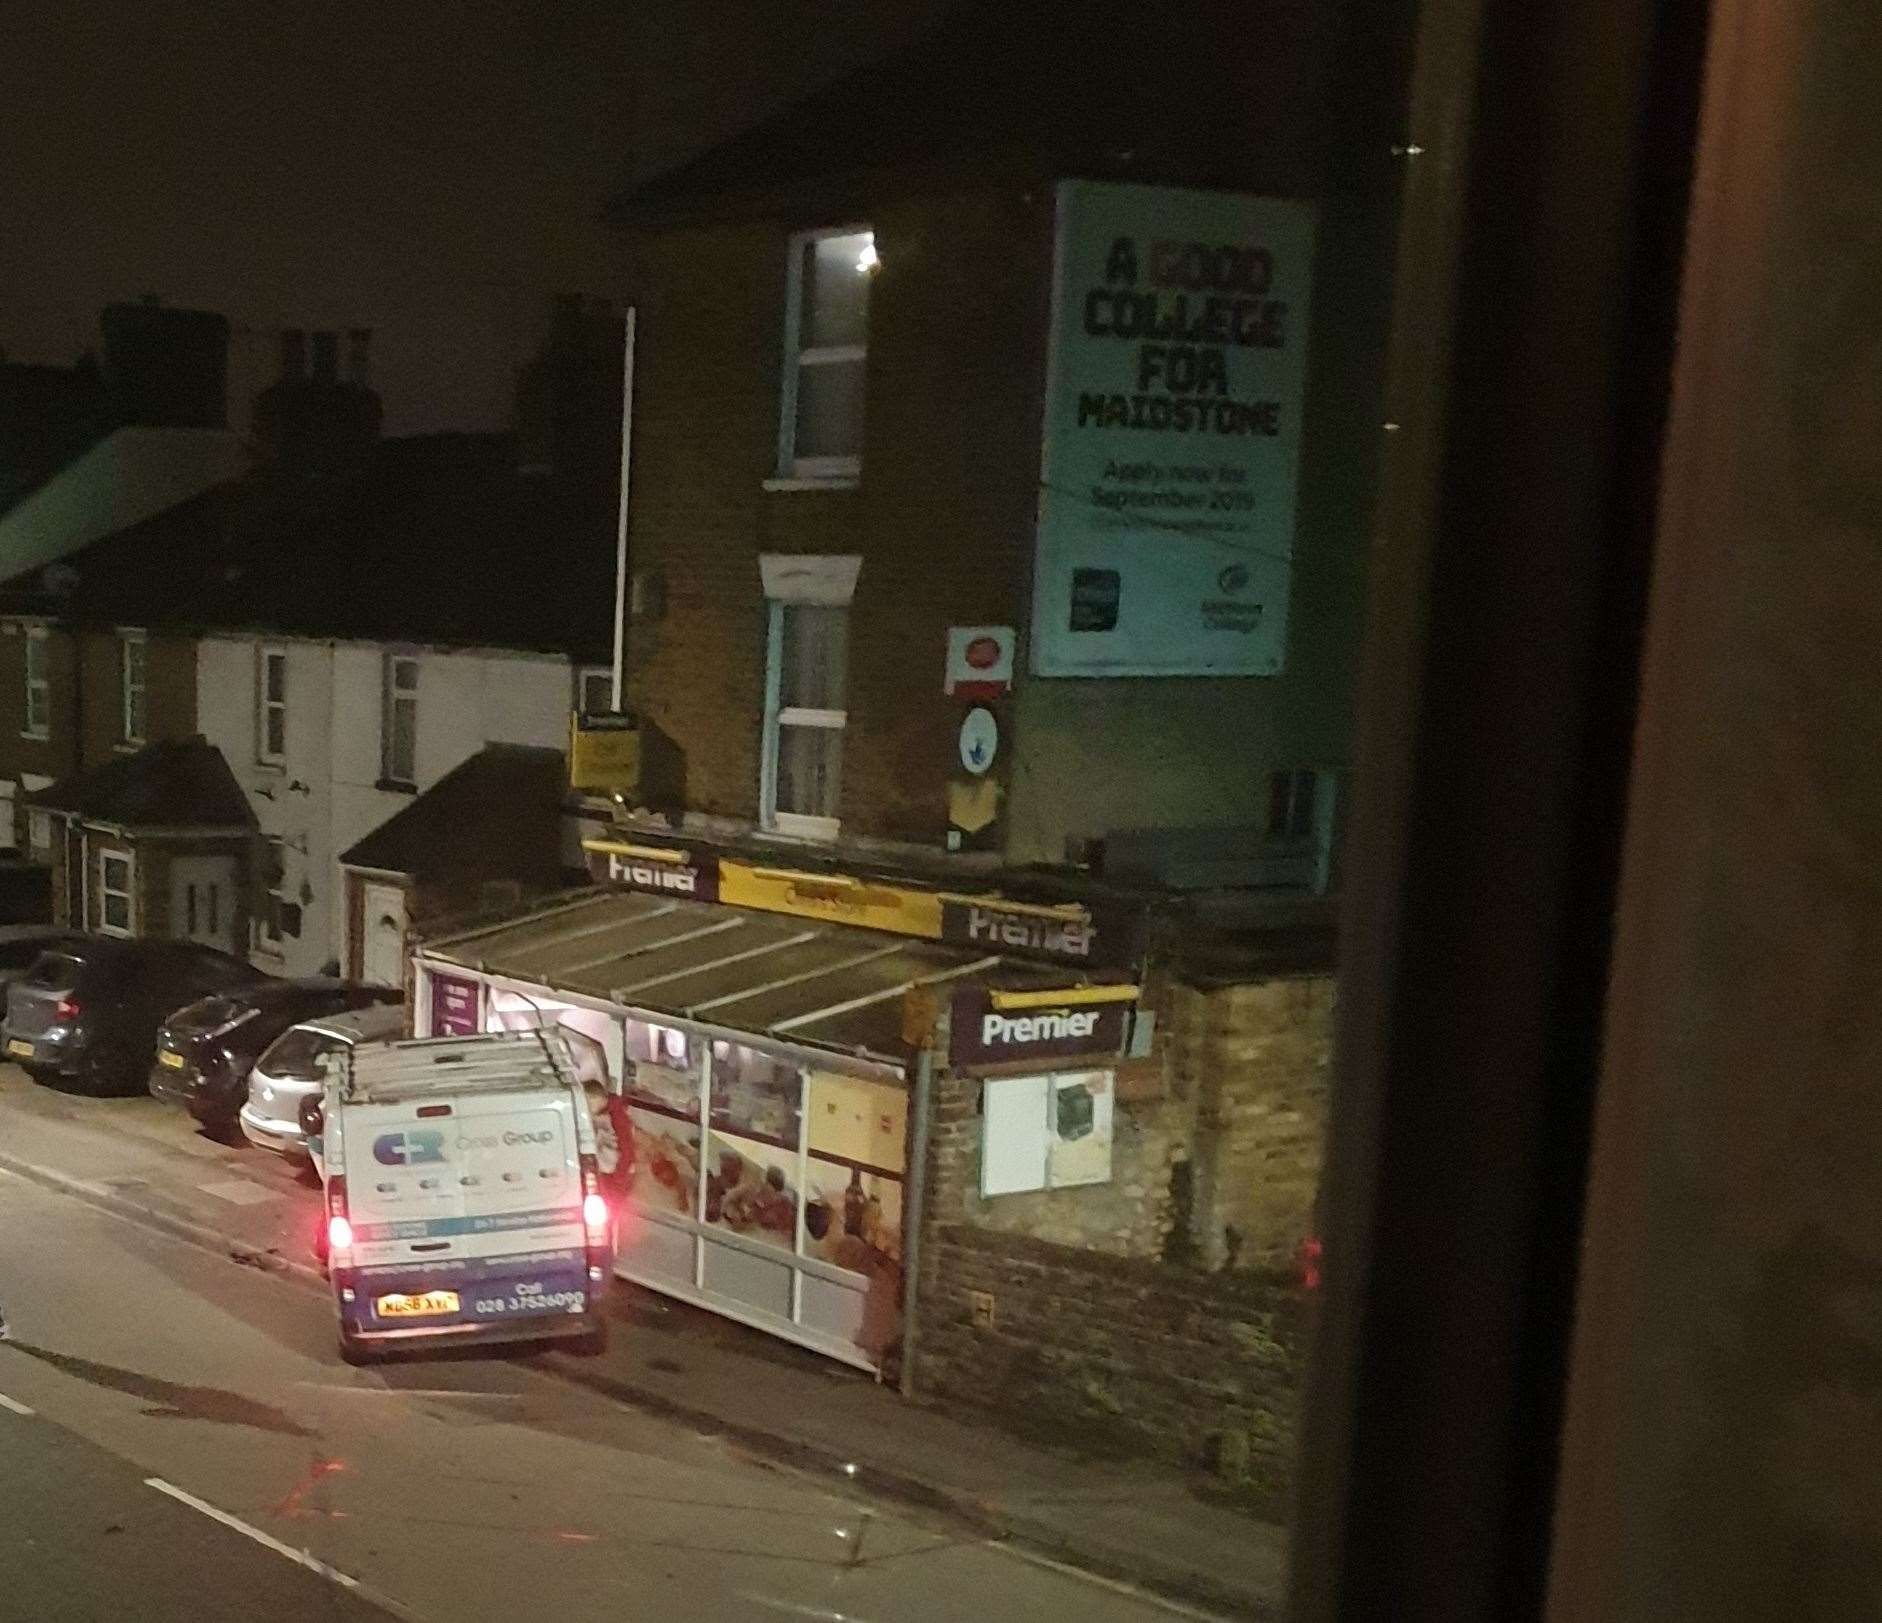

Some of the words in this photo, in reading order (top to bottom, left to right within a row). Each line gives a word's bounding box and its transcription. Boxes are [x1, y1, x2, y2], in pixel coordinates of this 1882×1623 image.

[1107, 238, 1136, 284] A
[1150, 240, 1272, 294] GOOD
[1083, 288, 1286, 347] COLLEGE
[1138, 343, 1227, 395] FOR
[1077, 391, 1278, 435] MAIDSTONE
[1104, 460, 1163, 485] Apply
[1091, 487, 1205, 512] September
[982, 1012, 1100, 1045] Premier
[503, 1131, 554, 1147] Group
[474, 1297, 503, 1312] 028
